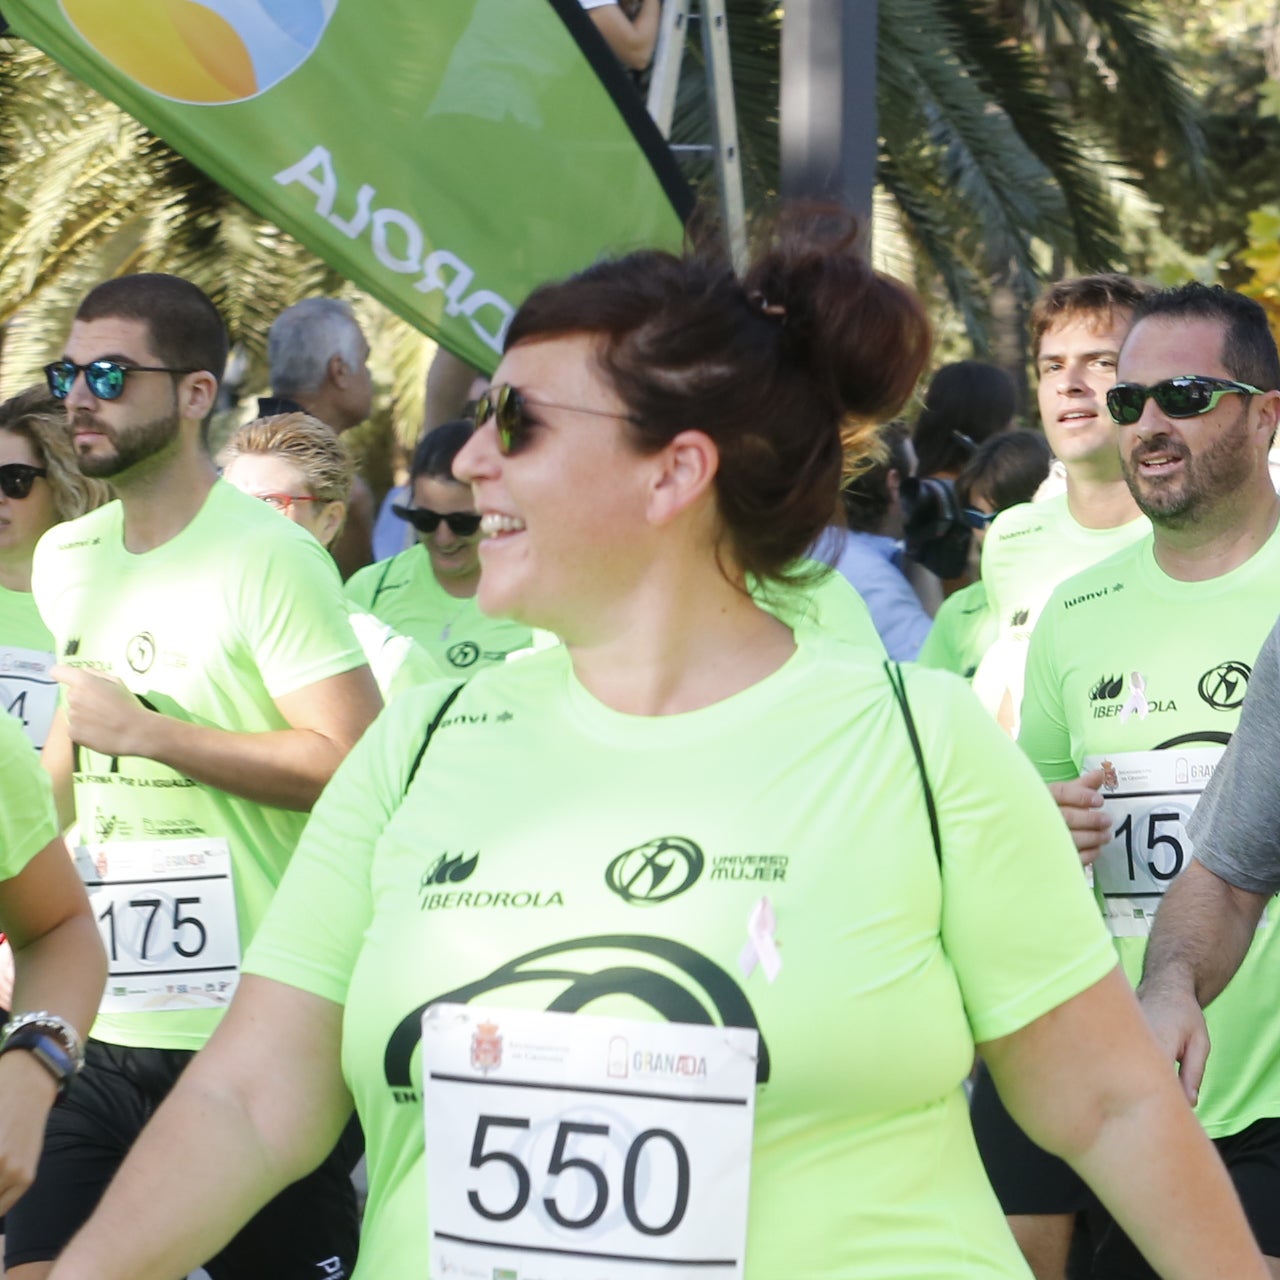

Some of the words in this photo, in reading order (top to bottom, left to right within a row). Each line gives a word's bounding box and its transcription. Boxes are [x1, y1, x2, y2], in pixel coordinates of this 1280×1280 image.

[1064, 586, 1109, 610] luanvi
[440, 713, 488, 728] anvi
[1093, 699, 1178, 719] IBEROLA
[1114, 812, 1184, 881] 15
[420, 890, 565, 912] IBERDROLA
[99, 896, 207, 962] 175
[465, 1113, 691, 1238] 550
